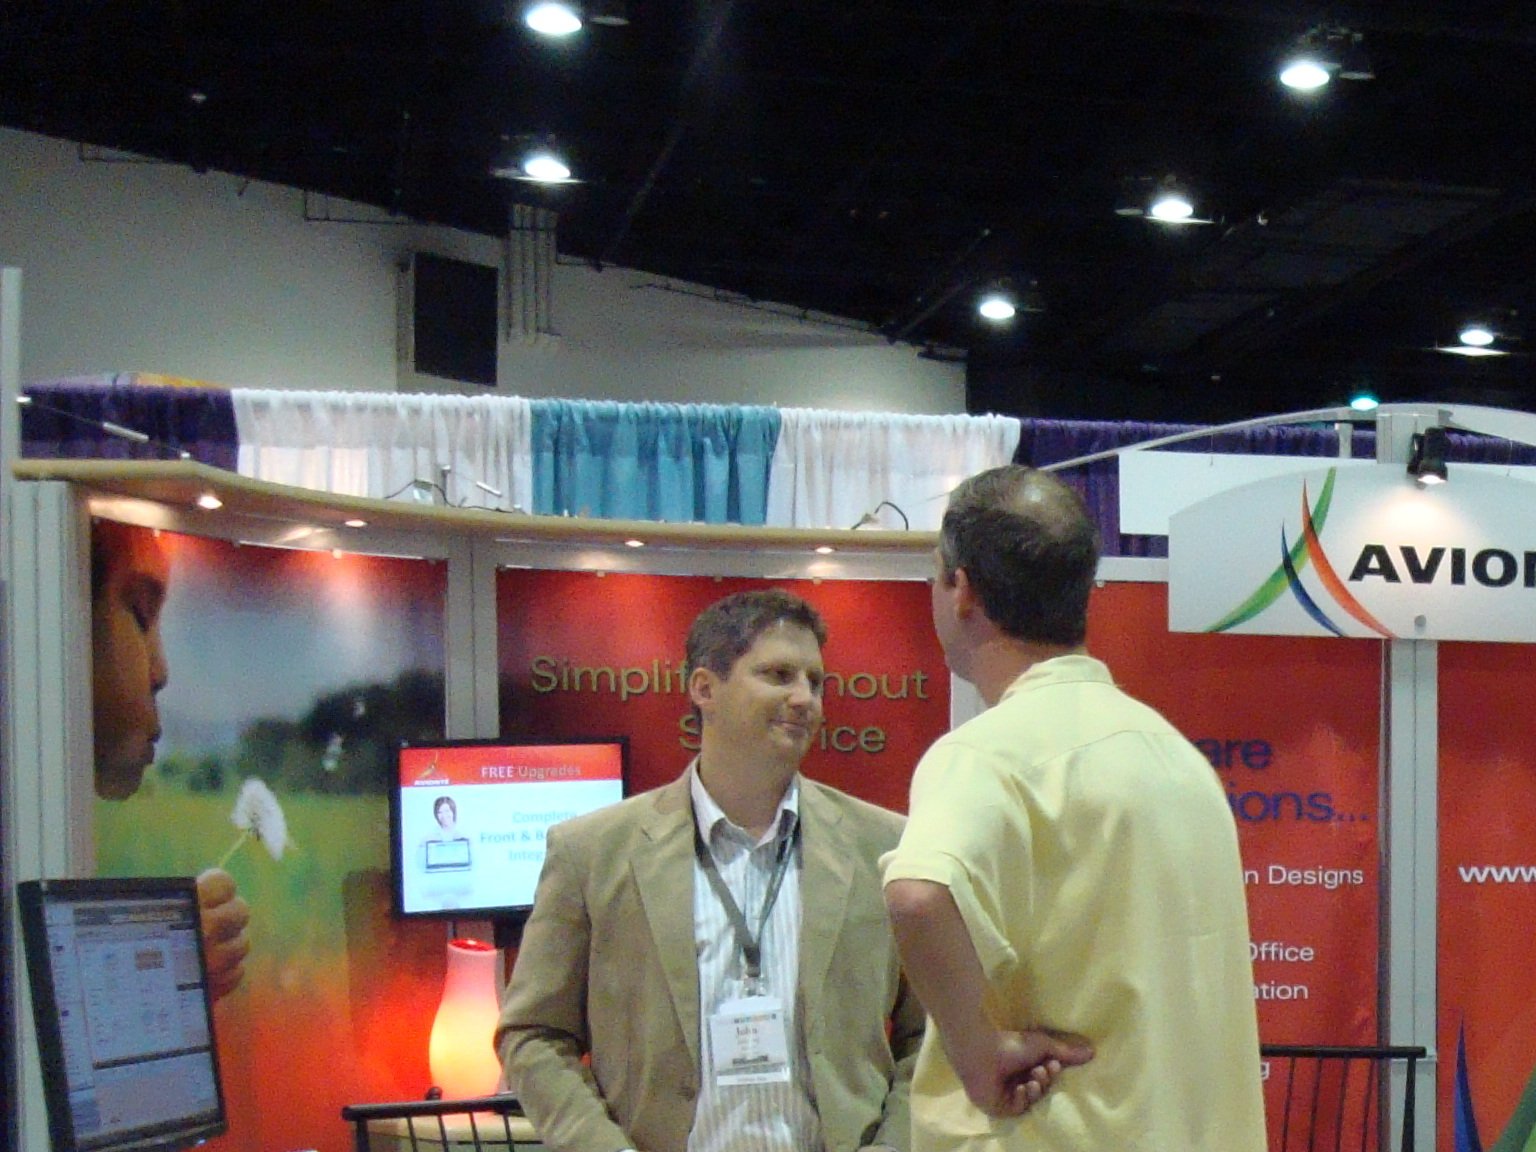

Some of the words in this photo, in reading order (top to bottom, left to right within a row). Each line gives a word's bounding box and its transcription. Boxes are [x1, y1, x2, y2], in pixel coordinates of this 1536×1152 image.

[481, 766, 513, 778] FREE
[518, 764, 580, 780] Upgrades
[1267, 865, 1364, 889] Designs
